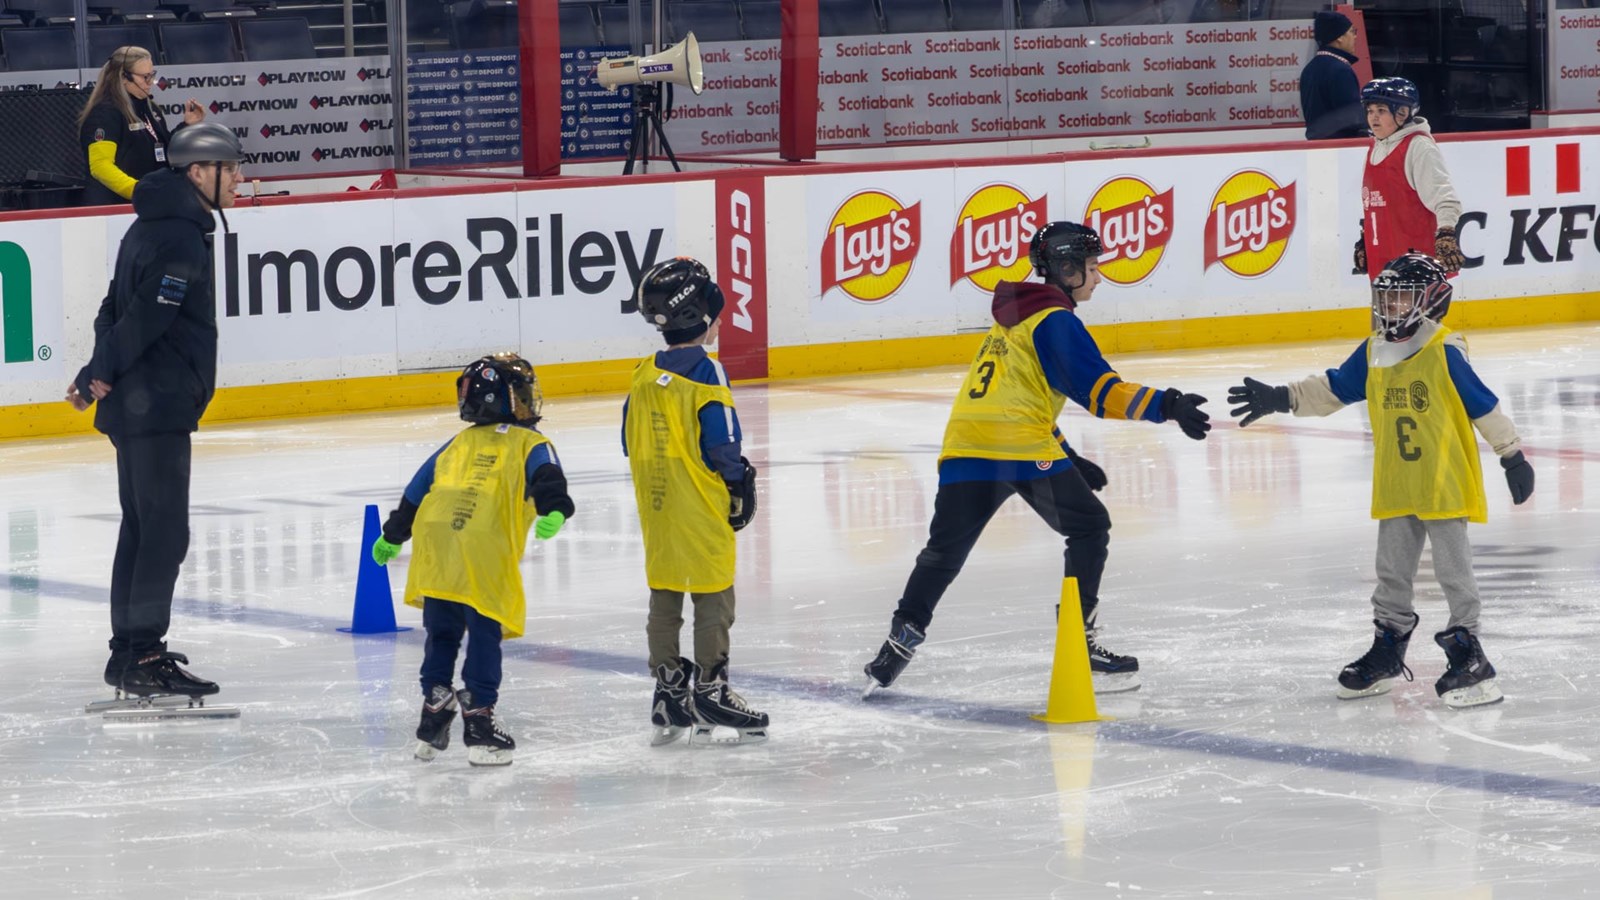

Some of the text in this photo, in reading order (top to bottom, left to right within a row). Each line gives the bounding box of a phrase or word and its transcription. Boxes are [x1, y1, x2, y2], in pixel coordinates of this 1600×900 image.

[836, 40, 912, 57] Scotiabank
[925, 37, 1000, 53] Scotiabank
[1014, 34, 1088, 50] Scotiabank
[1100, 31, 1174, 47] Scotiabank
[1186, 28, 1257, 44] Scotiabank
[168, 70, 346, 88] PLAYNOW PLAYNOW
[882, 52, 1298, 82] Scotiabank Scotiabank Scotiabank Scotiabank Scotiabank
[220, 98, 298, 112] PLAYNOW
[838, 94, 914, 111] Scotiabank
[928, 90, 1002, 106] Scotiabank
[1015, 87, 1088, 102] Scotiabank
[1101, 84, 1174, 99] Scotiabank
[1186, 80, 1257, 96] Scotiabank
[271, 122, 348, 136] PLAYNOW
[884, 120, 959, 136] Scotiabank
[972, 116, 1046, 132] Scotiabank
[1058, 112, 1132, 128] Scotiabank
[1144, 108, 1216, 124] Scotiabank
[1229, 105, 1300, 120] Scotiabank
[702, 128, 779, 146] Scotiabank
[963, 204, 1038, 275] Lay's
[1216, 190, 1288, 258] Lay's
[1371, 212, 1378, 246] 1
[1503, 204, 1600, 266] KF
[730, 189, 753, 332] CCM
[834, 210, 911, 282] Lay's
[968, 361, 995, 399] 3
